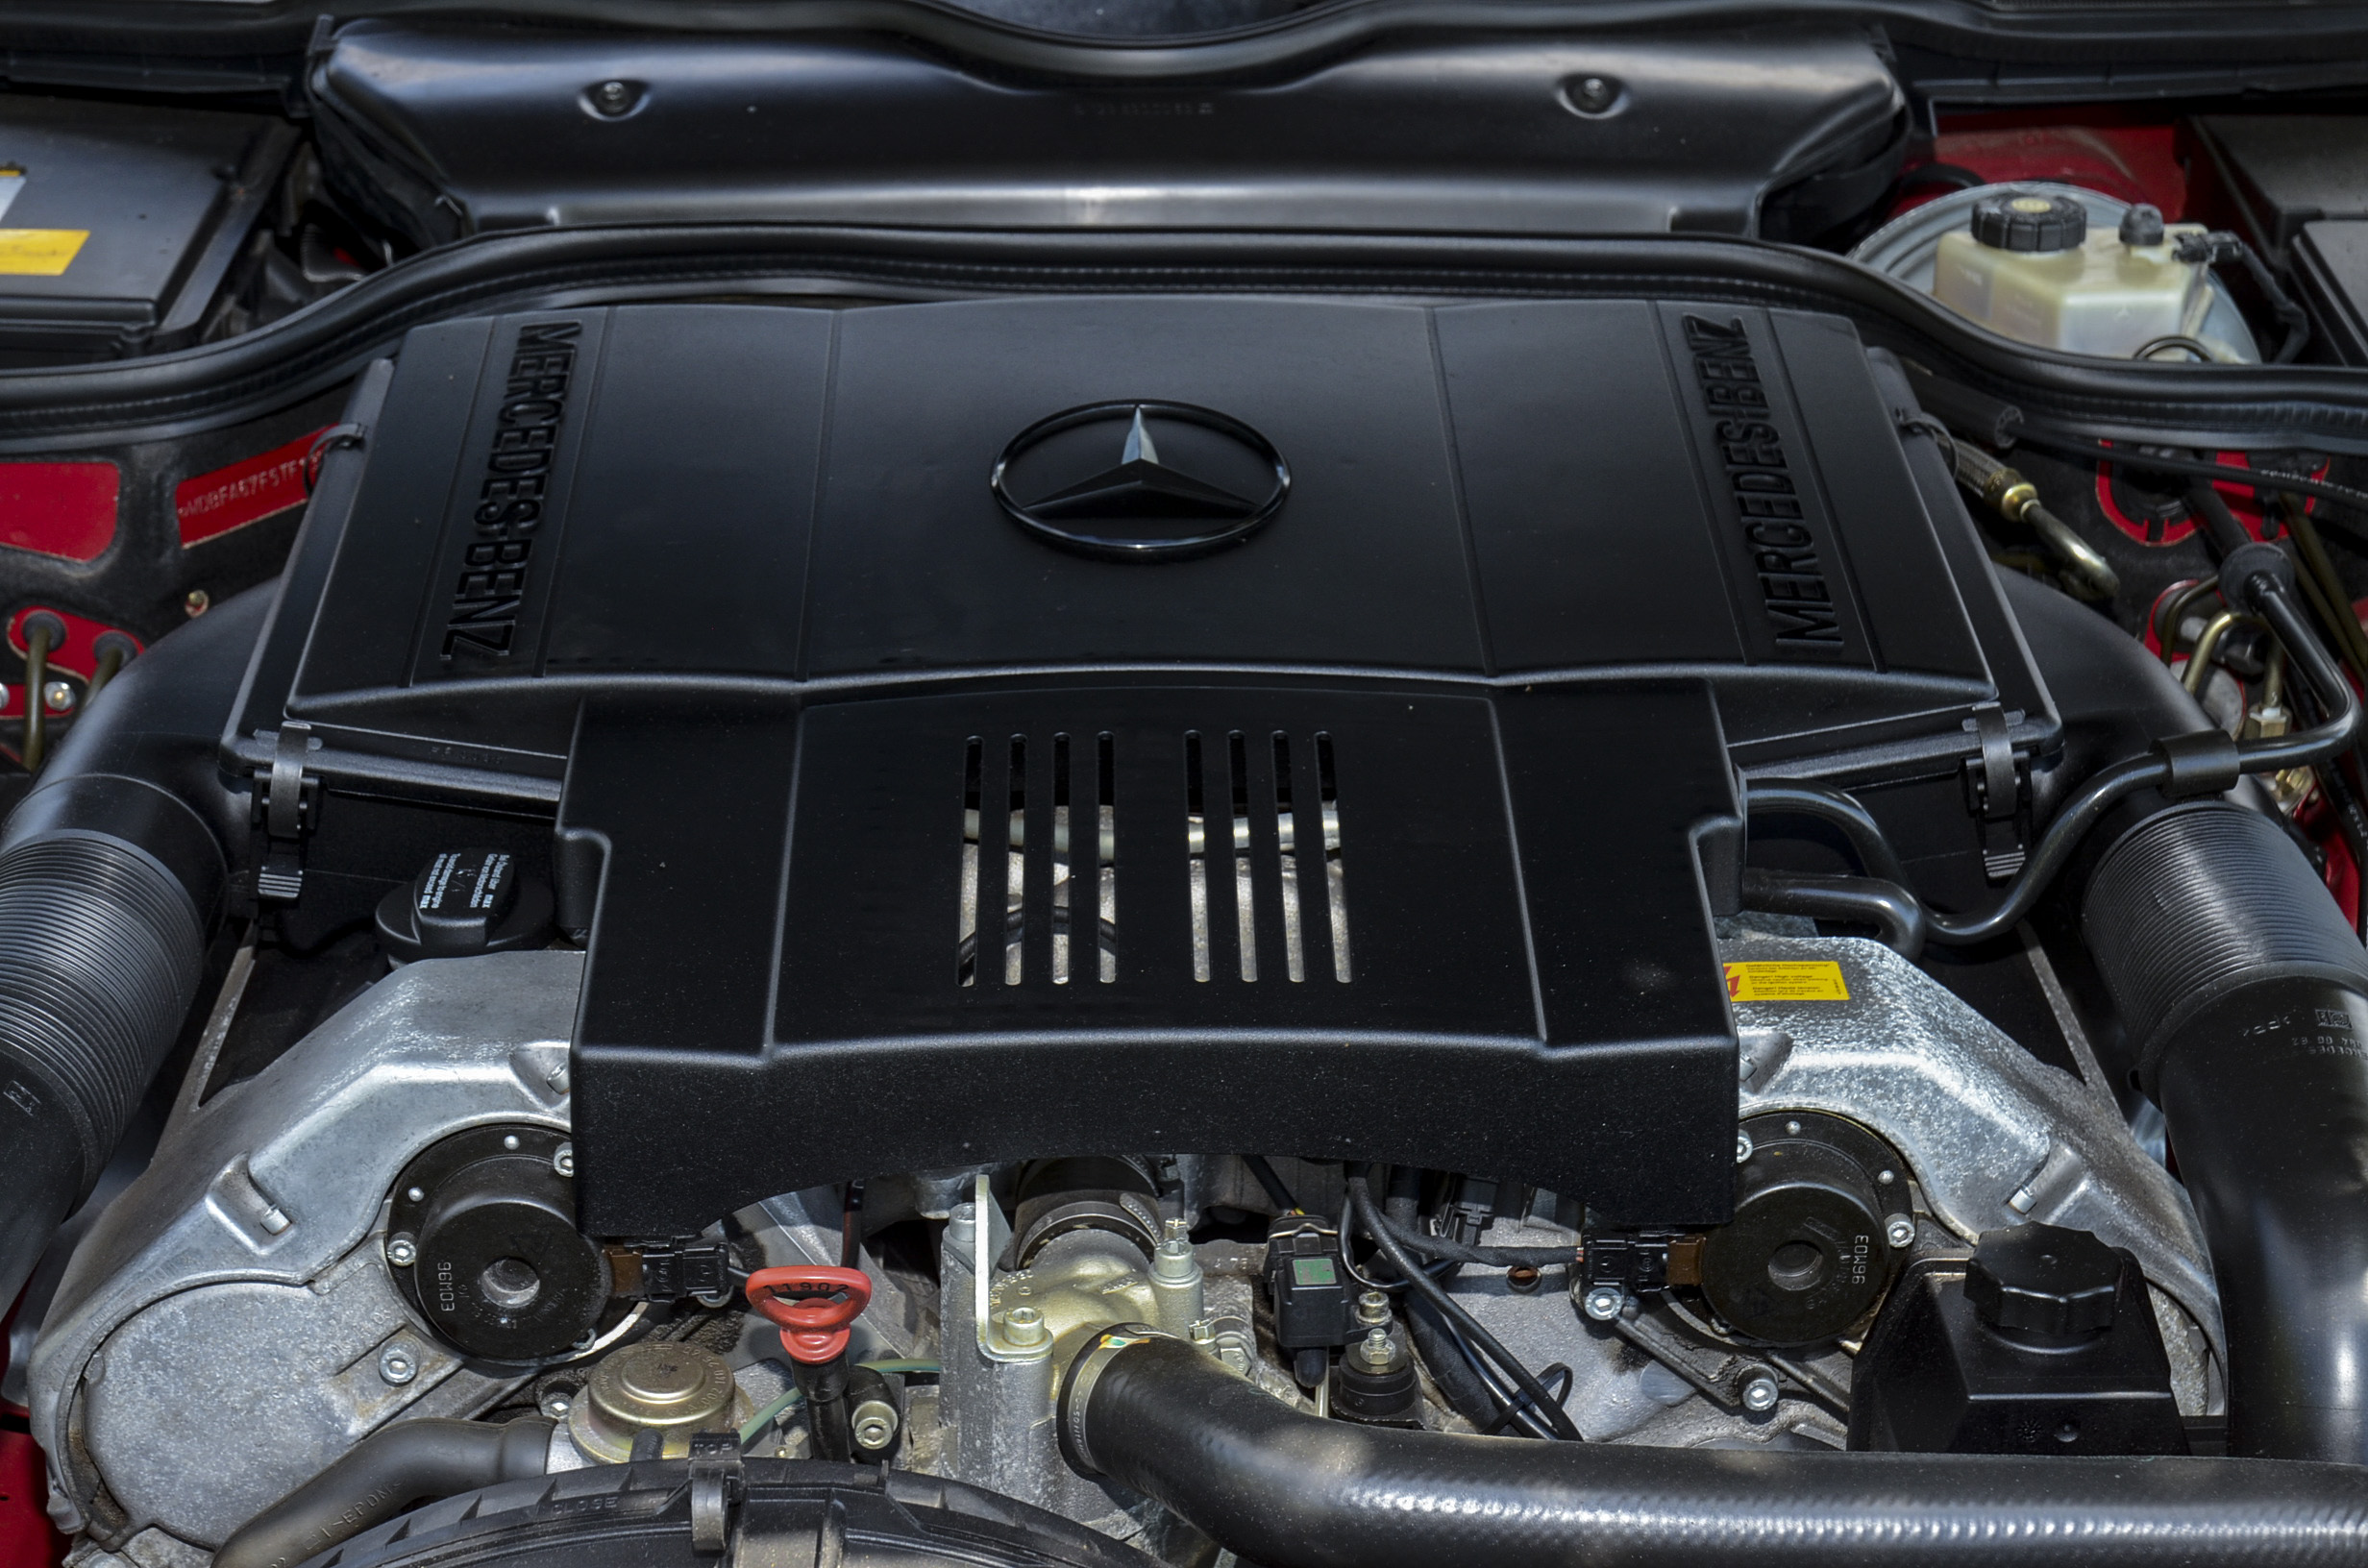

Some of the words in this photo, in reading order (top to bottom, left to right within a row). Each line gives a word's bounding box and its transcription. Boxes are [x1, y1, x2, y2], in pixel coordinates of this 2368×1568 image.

[440, 321, 582, 662] MERCEDES-BENZ
[1681, 313, 1844, 649] MERCEDES-BENZ
[1851, 1235, 1868, 1284] 96M03
[437, 1262, 456, 1311] 96M03
[694, 1442, 733, 1456] TOP
[551, 1496, 618, 1516] CLOSE
